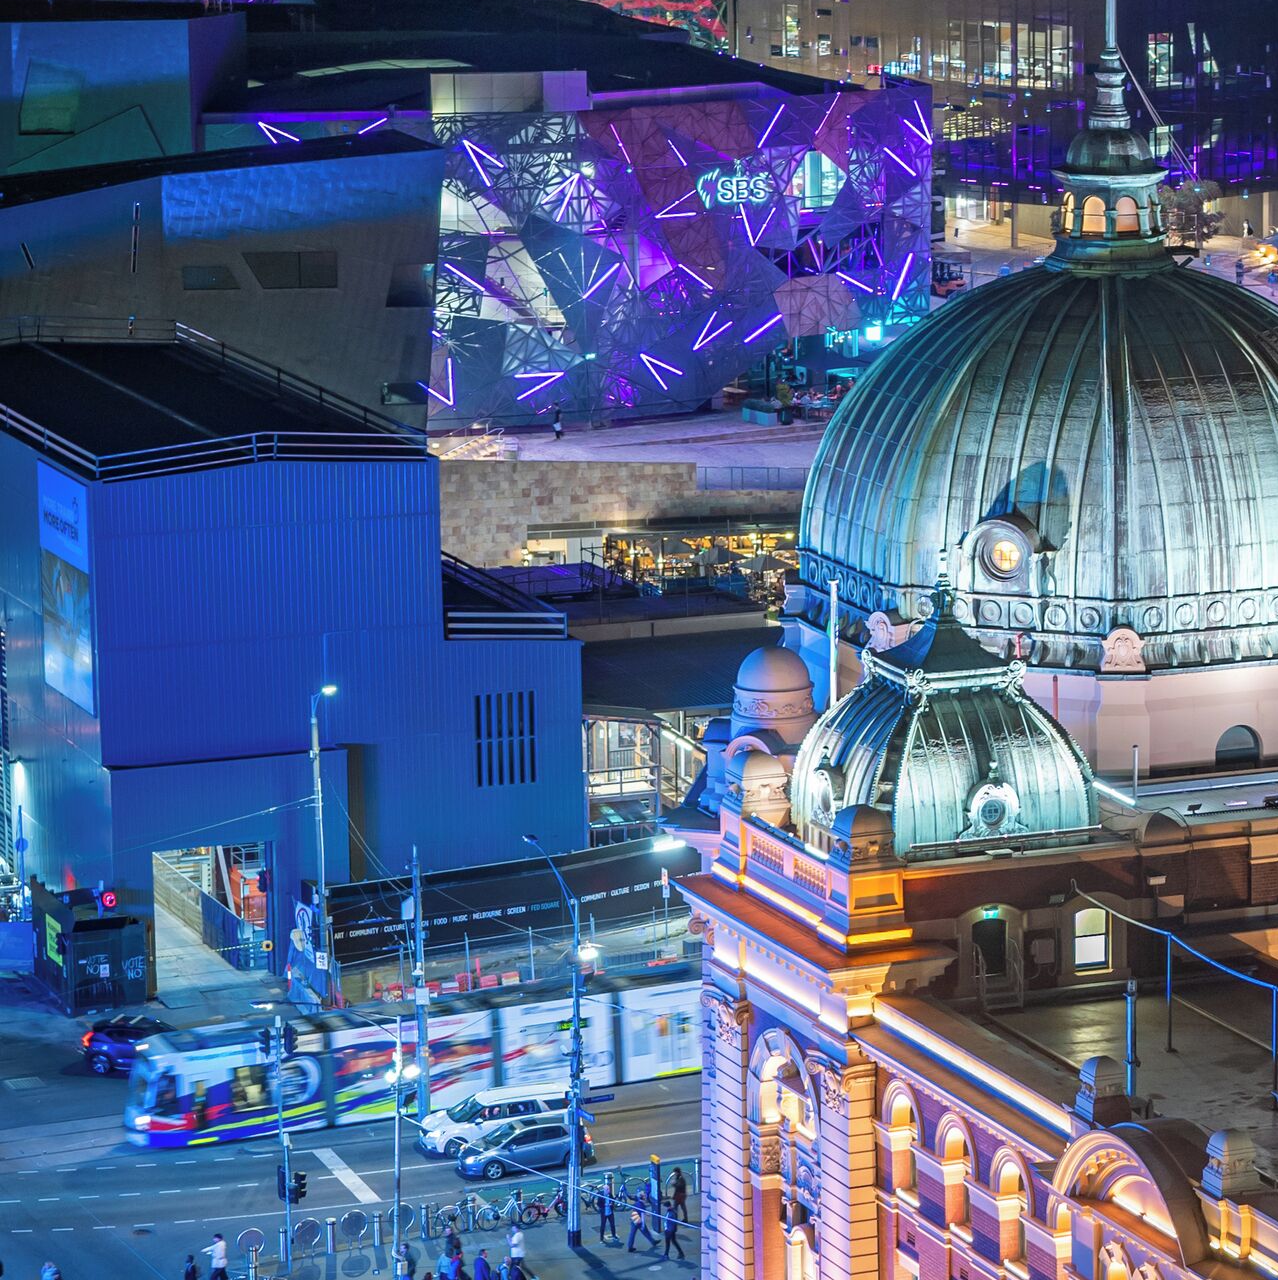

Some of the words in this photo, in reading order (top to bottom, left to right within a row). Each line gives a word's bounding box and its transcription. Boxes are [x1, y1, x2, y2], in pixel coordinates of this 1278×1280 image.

[718, 177, 768, 201] SBS
[581, 892, 607, 903] COMMUNITY
[610, 887, 630, 897] CULTURE
[633, 882, 650, 892] DESIGN
[334, 932, 344, 940] ART
[349, 927, 379, 938] COMMUNITY
[384, 923, 405, 933] CULTURE
[433, 918, 448, 926] FOOD
[452, 914, 468, 923] MUSIC
[472, 909, 502, 920] MELBOURNE
[506, 906, 526, 916] SCREEN
[122, 956, 146, 970] VOTE
[127, 968, 142, 980] NO
